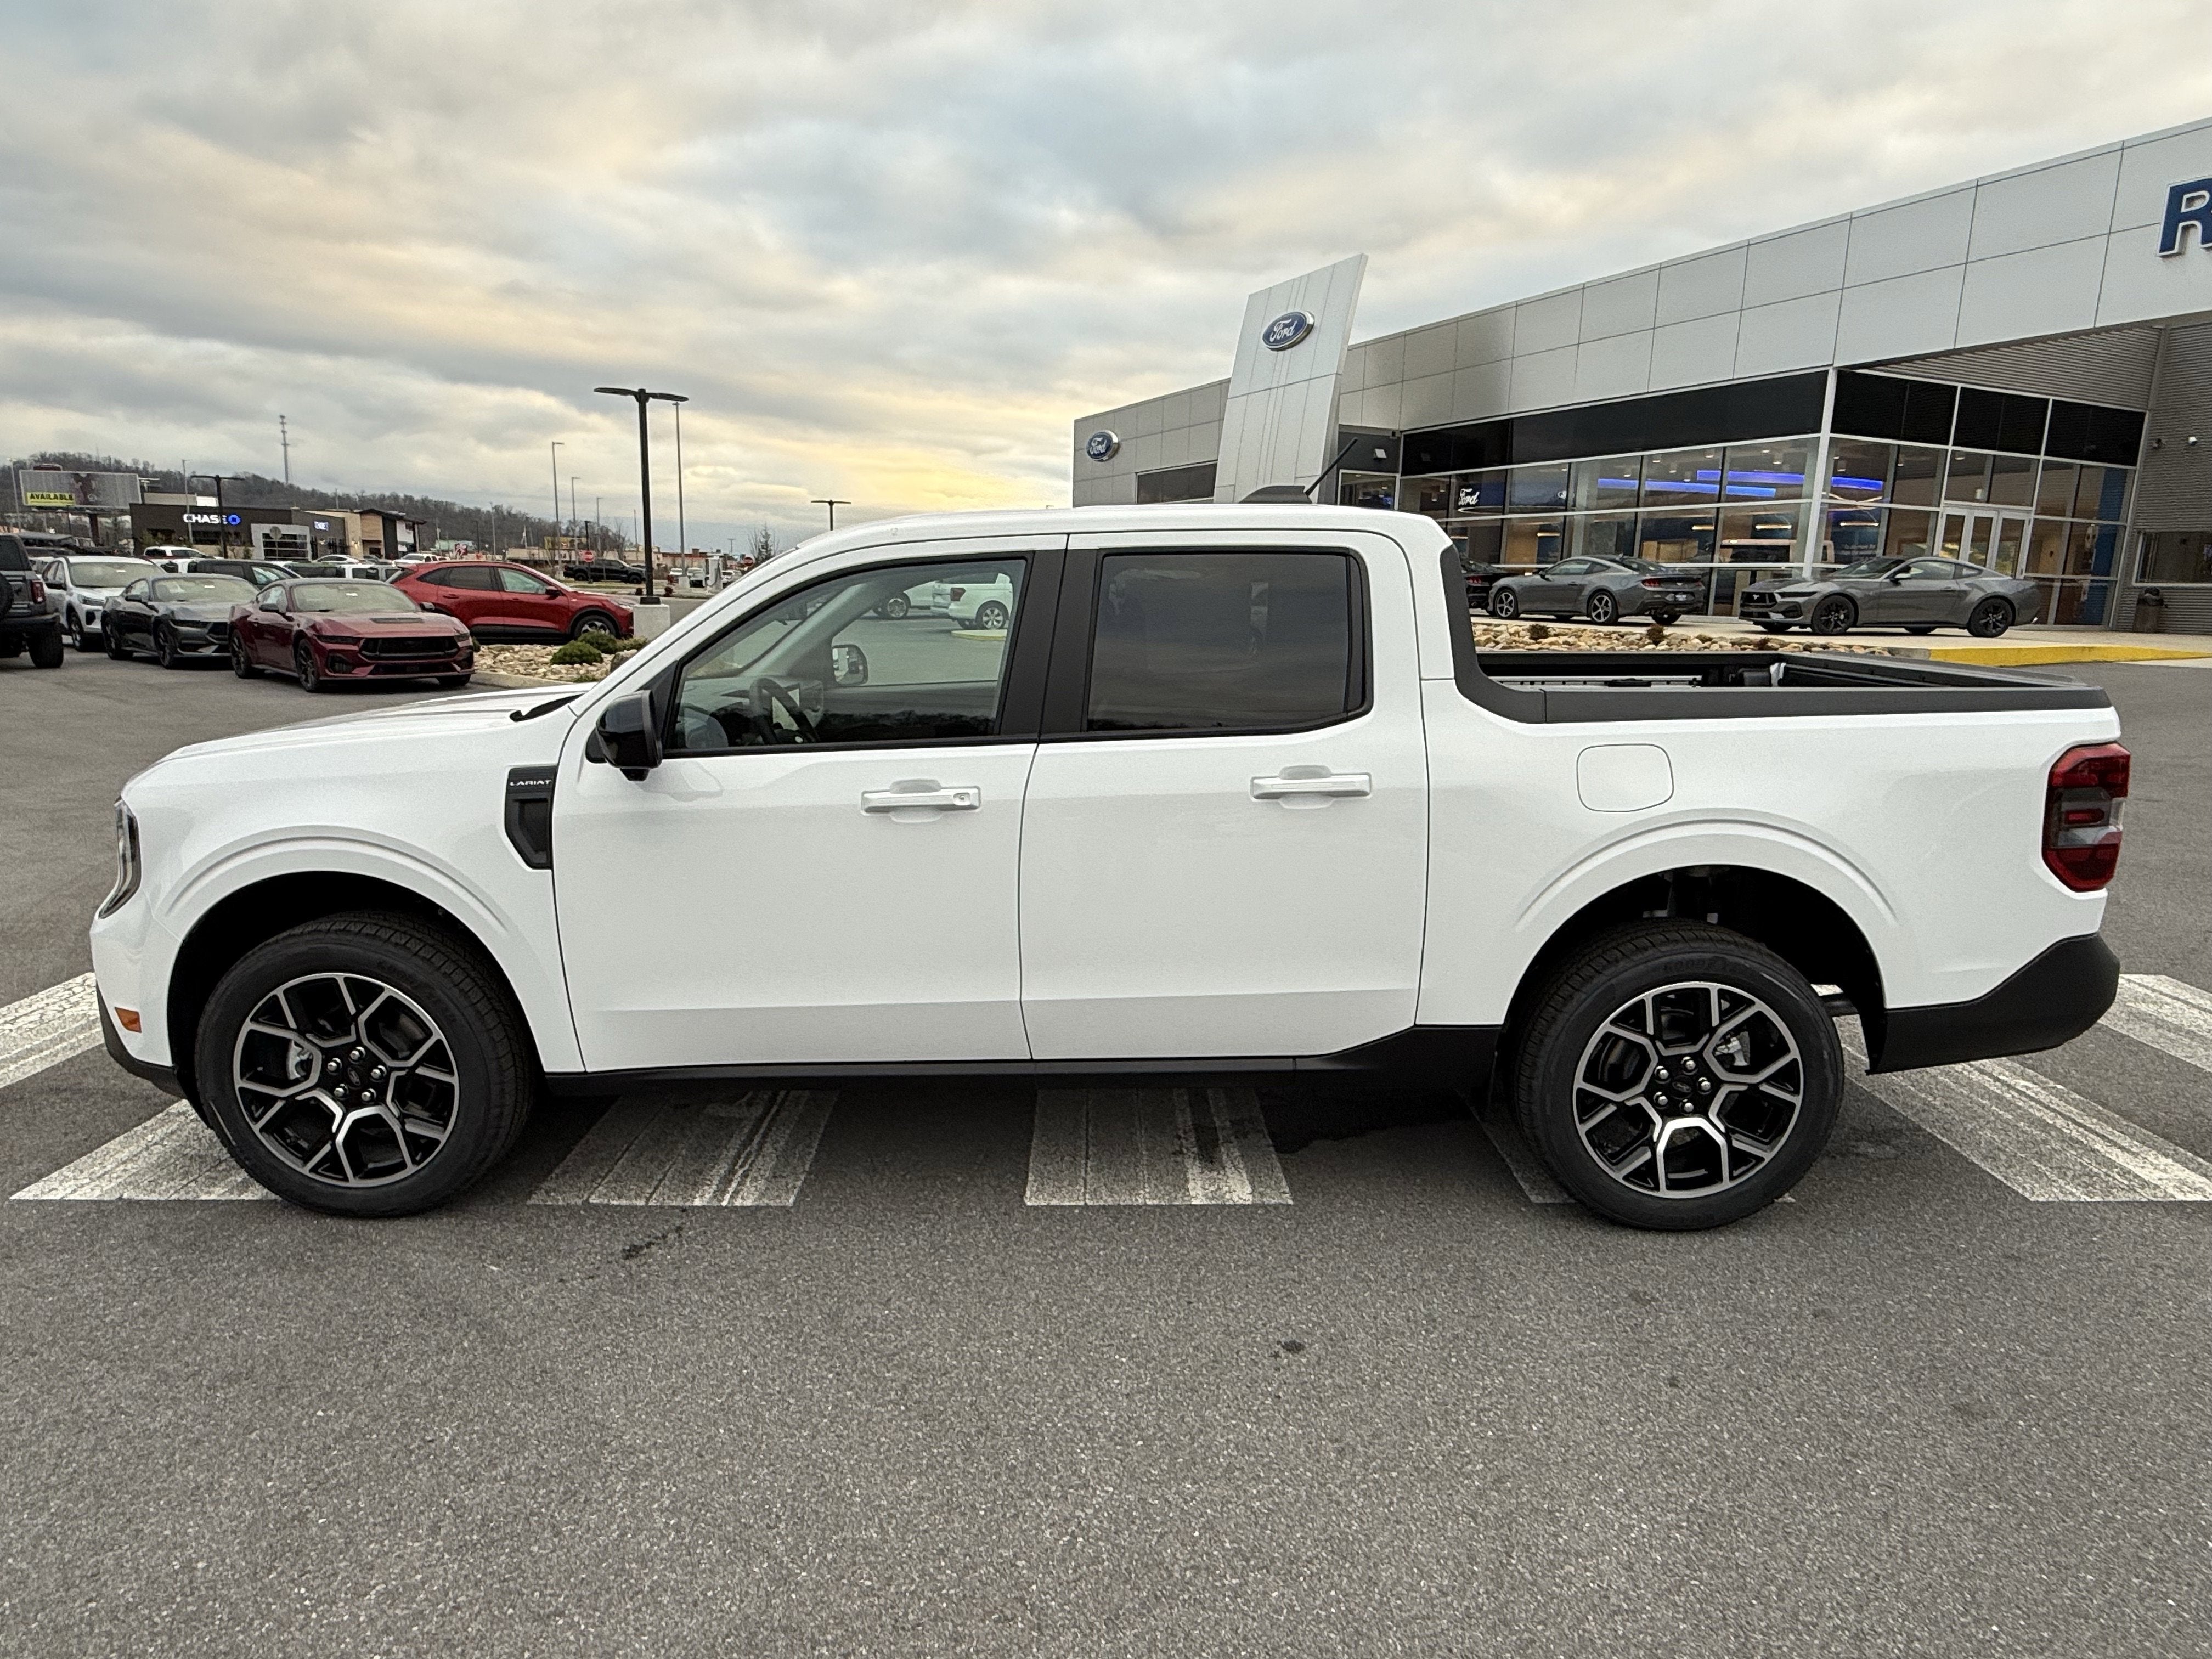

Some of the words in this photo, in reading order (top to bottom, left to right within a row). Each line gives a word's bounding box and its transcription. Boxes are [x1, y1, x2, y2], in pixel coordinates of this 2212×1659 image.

[1269, 318, 1298, 342] Ford
[1090, 437, 1107, 455] Ford
[1458, 488, 1480, 505] Ford
[183, 514, 227, 524] CHASE
